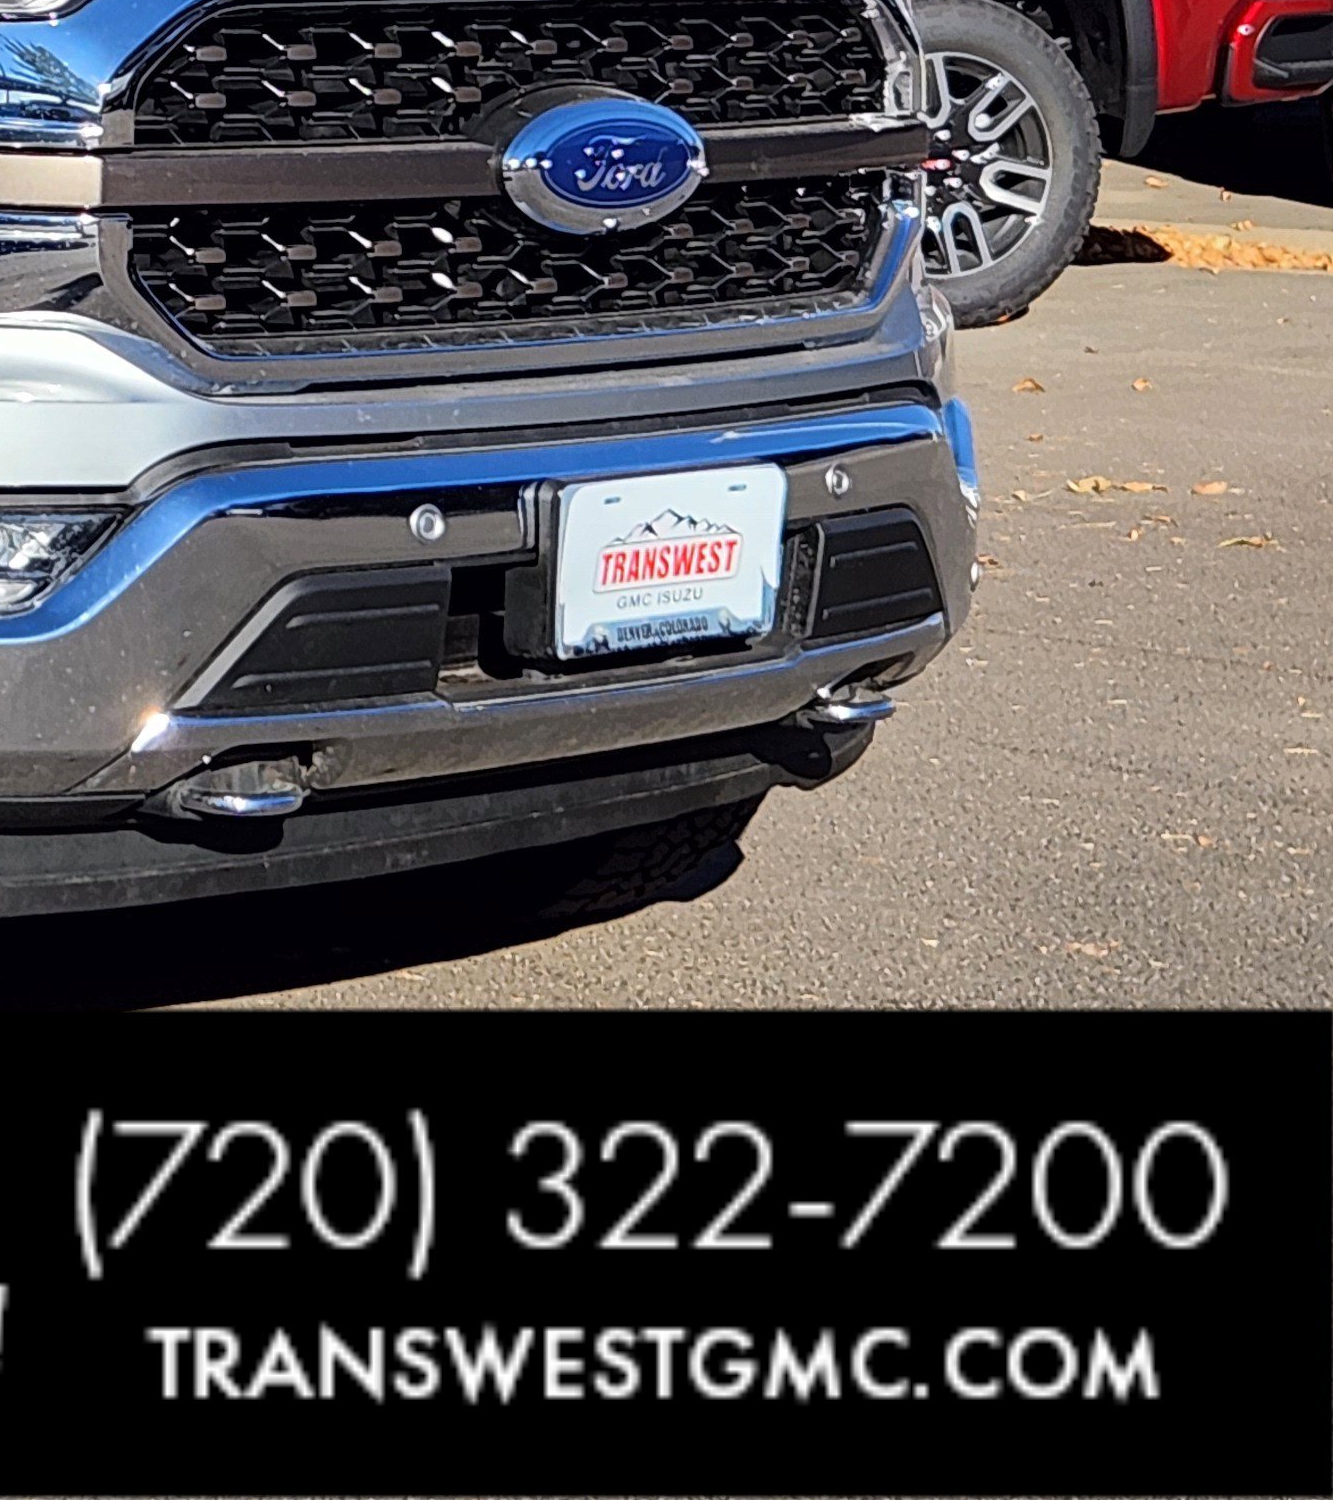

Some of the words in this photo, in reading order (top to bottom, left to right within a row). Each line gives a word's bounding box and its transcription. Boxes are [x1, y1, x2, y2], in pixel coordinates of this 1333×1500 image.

[574, 134, 668, 193] Ford
[600, 539, 738, 586] TRANSWEST
[616, 592, 652, 609] GMC
[657, 586, 703, 604] ISUZU
